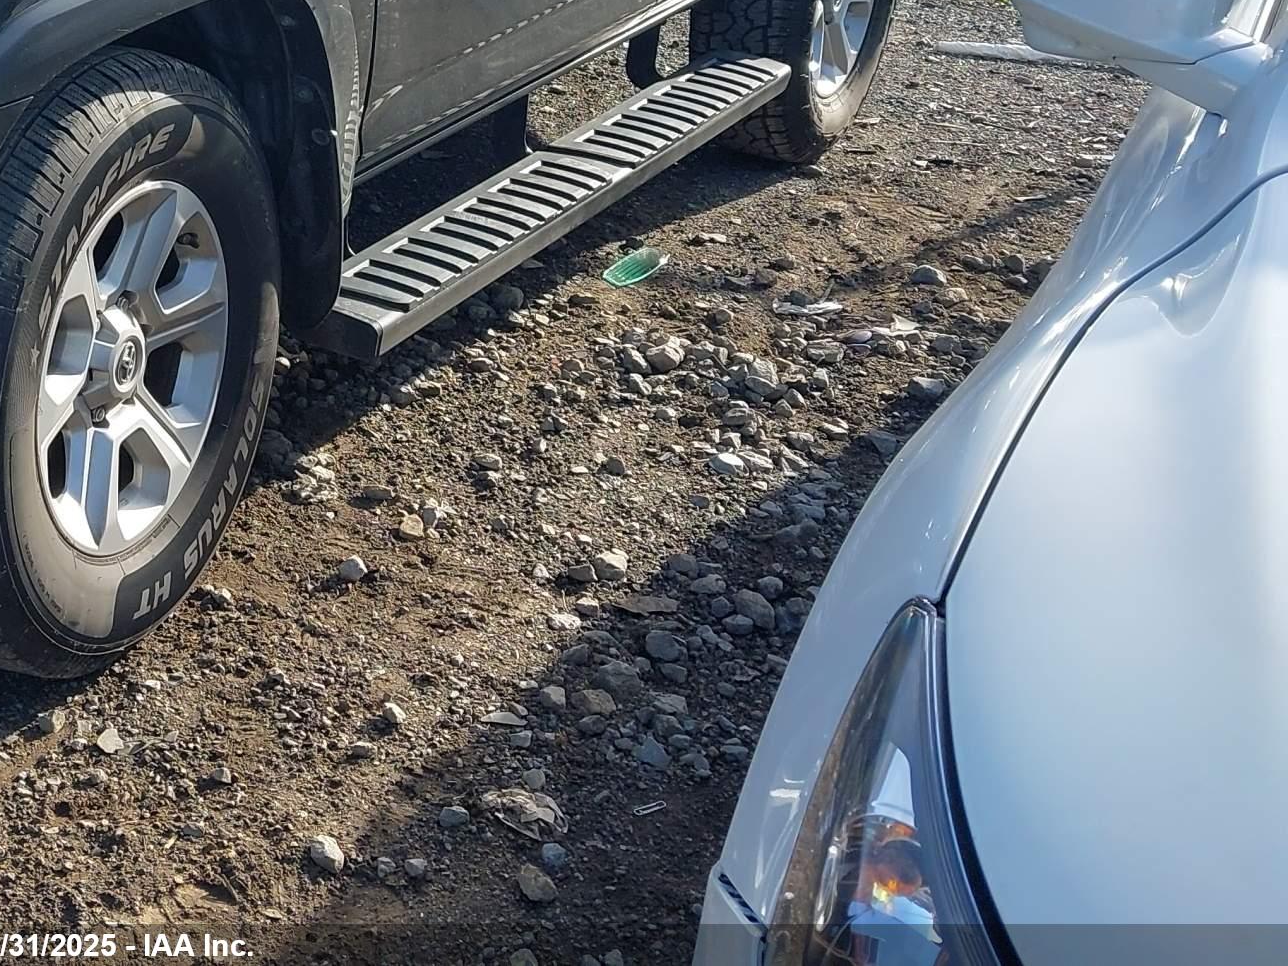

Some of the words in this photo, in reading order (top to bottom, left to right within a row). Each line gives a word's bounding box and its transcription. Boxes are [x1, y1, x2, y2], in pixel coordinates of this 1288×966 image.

[38, 123, 176, 339] STARFIRE
[183, 380, 265, 580] SOLARUS
[132, 571, 172, 620] HT
